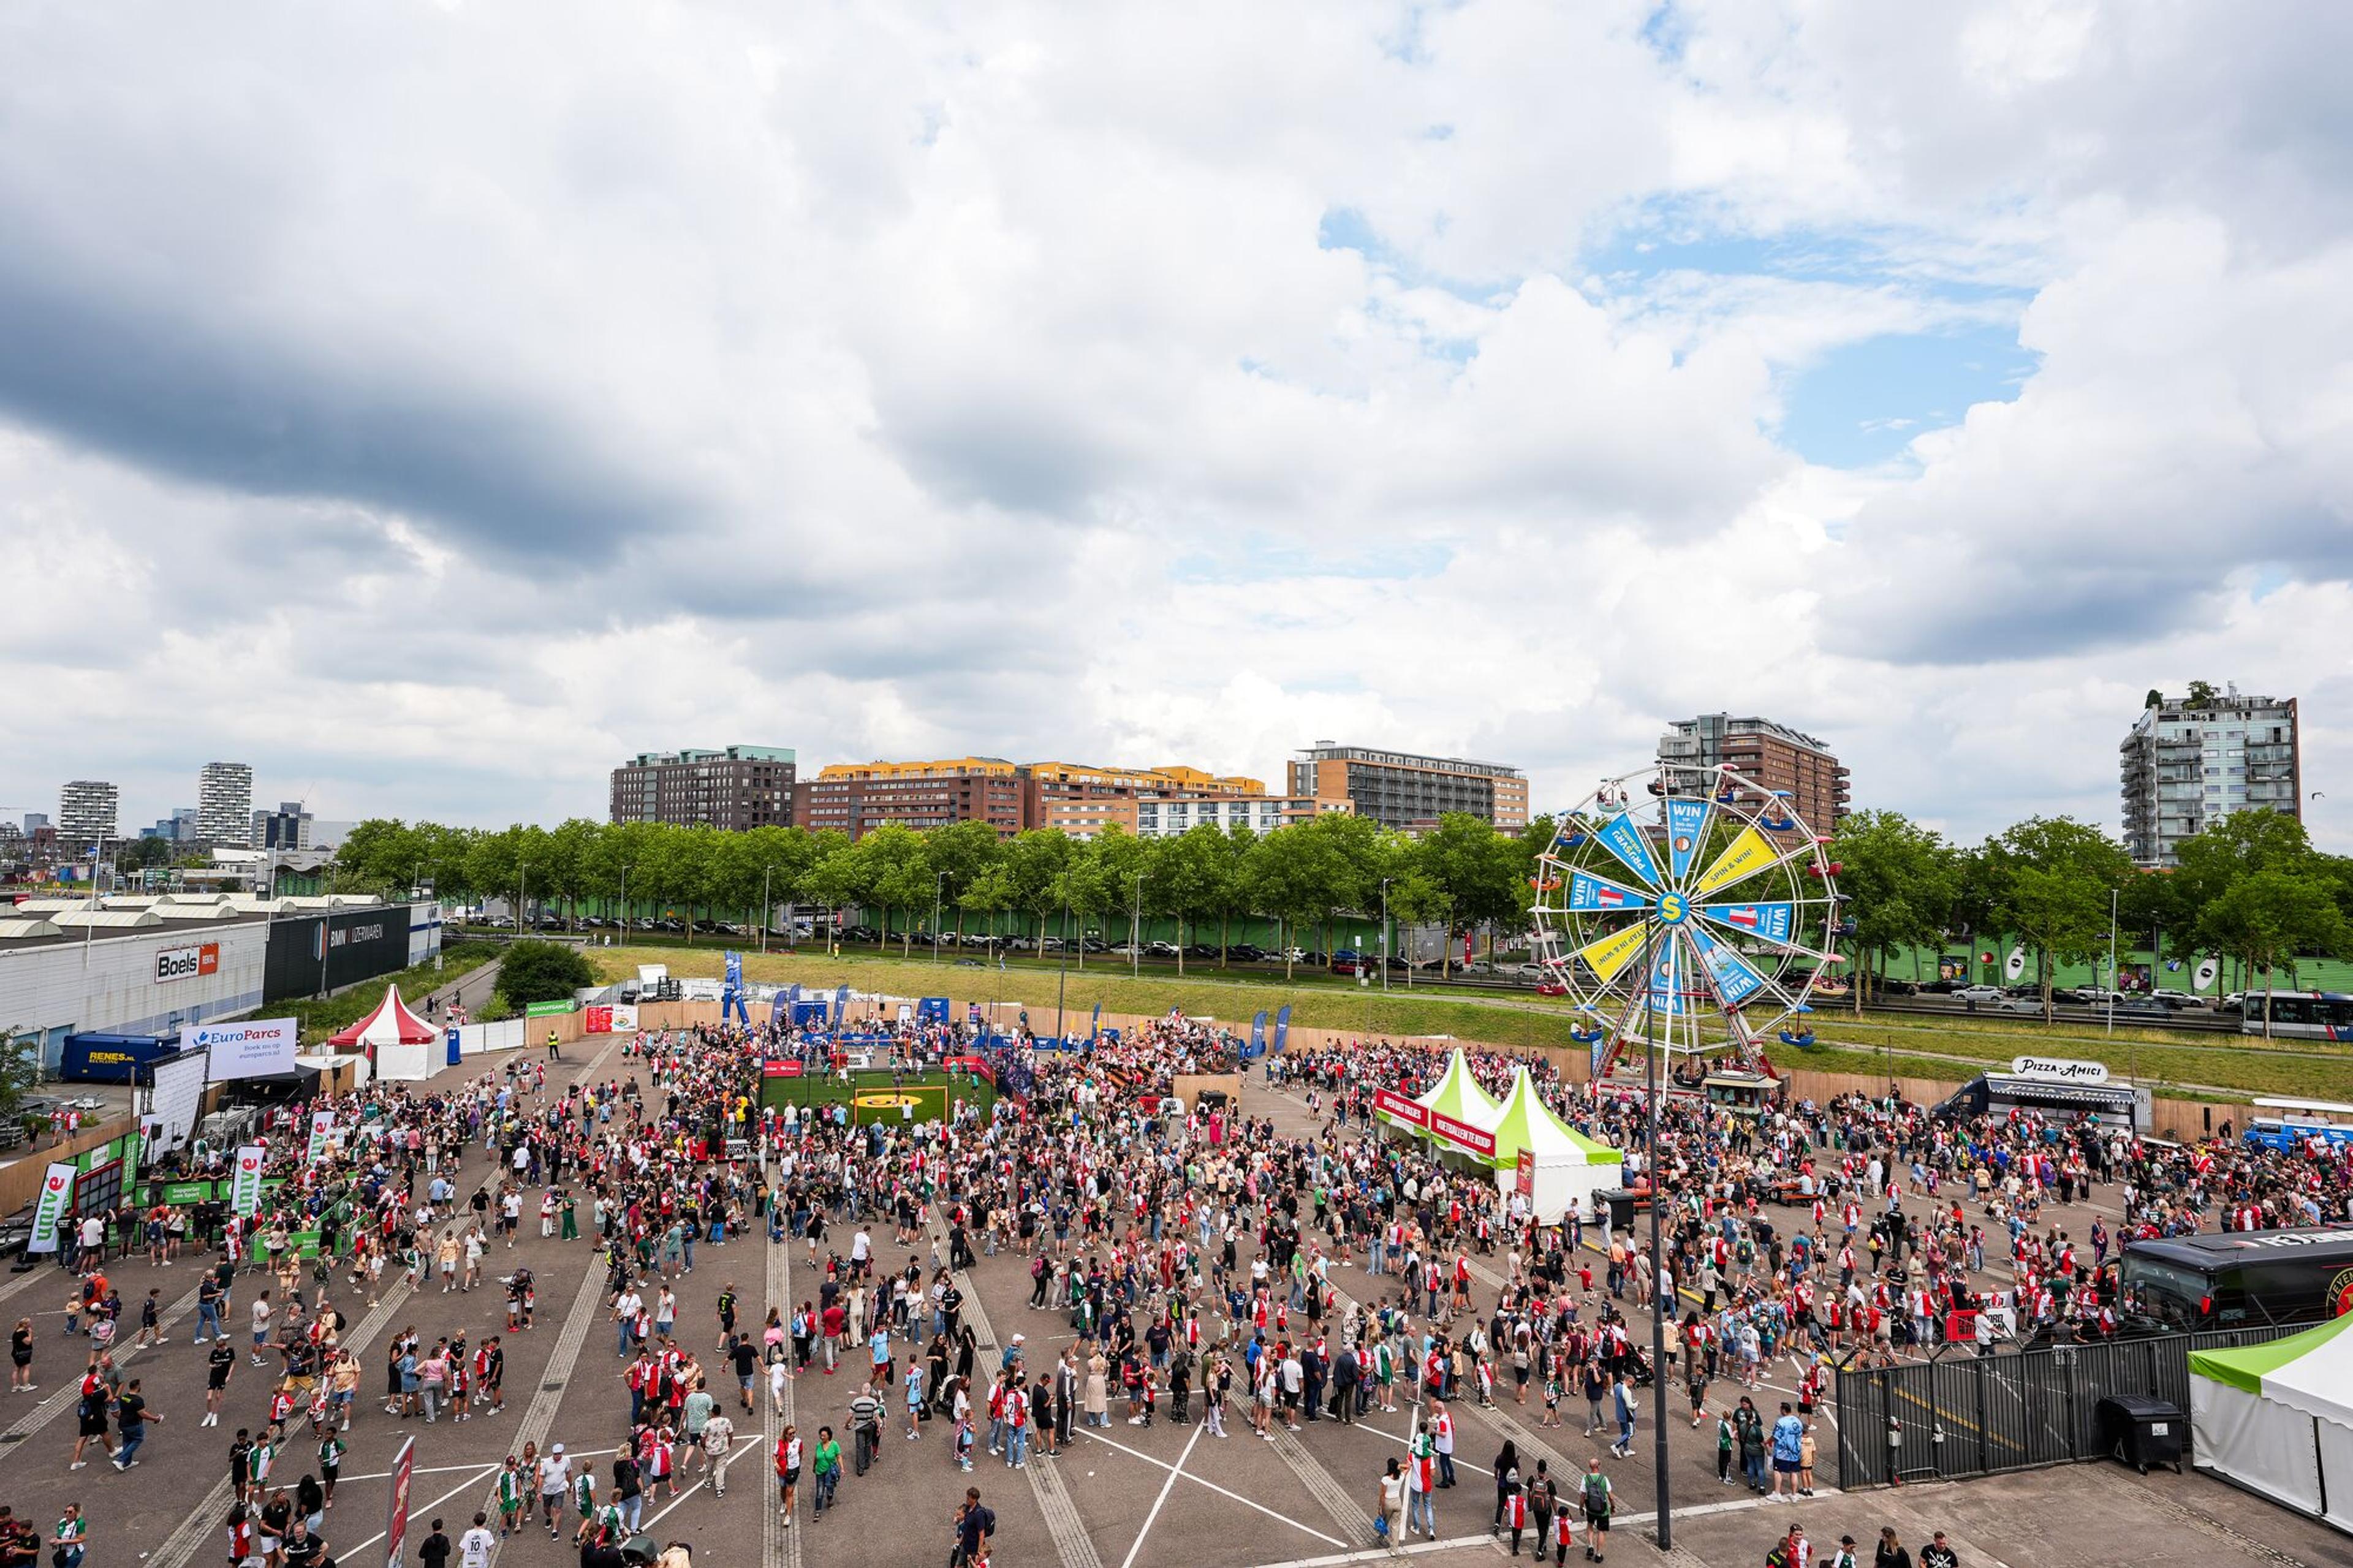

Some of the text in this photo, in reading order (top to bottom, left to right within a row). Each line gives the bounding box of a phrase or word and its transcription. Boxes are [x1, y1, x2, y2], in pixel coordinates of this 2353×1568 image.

[1673, 805, 1701, 817] WIN
[1710, 868, 1728, 883] SPIN
[1734, 848, 1754, 865] WIN!
[1574, 879, 1586, 905] WIN
[1662, 895, 1681, 920] S
[1772, 908, 1787, 936] WIN
[330, 929, 346, 947] BMN
[1629, 926, 1645, 944] STAP
[1620, 940, 1629, 949] IN
[158, 953, 197, 977] Boels
[1597, 952, 1615, 966] WIN!
[1726, 977, 1755, 999] WIN
[211, 1029, 281, 1043] EuroParcs
[470, 1541, 480, 1551] 10
